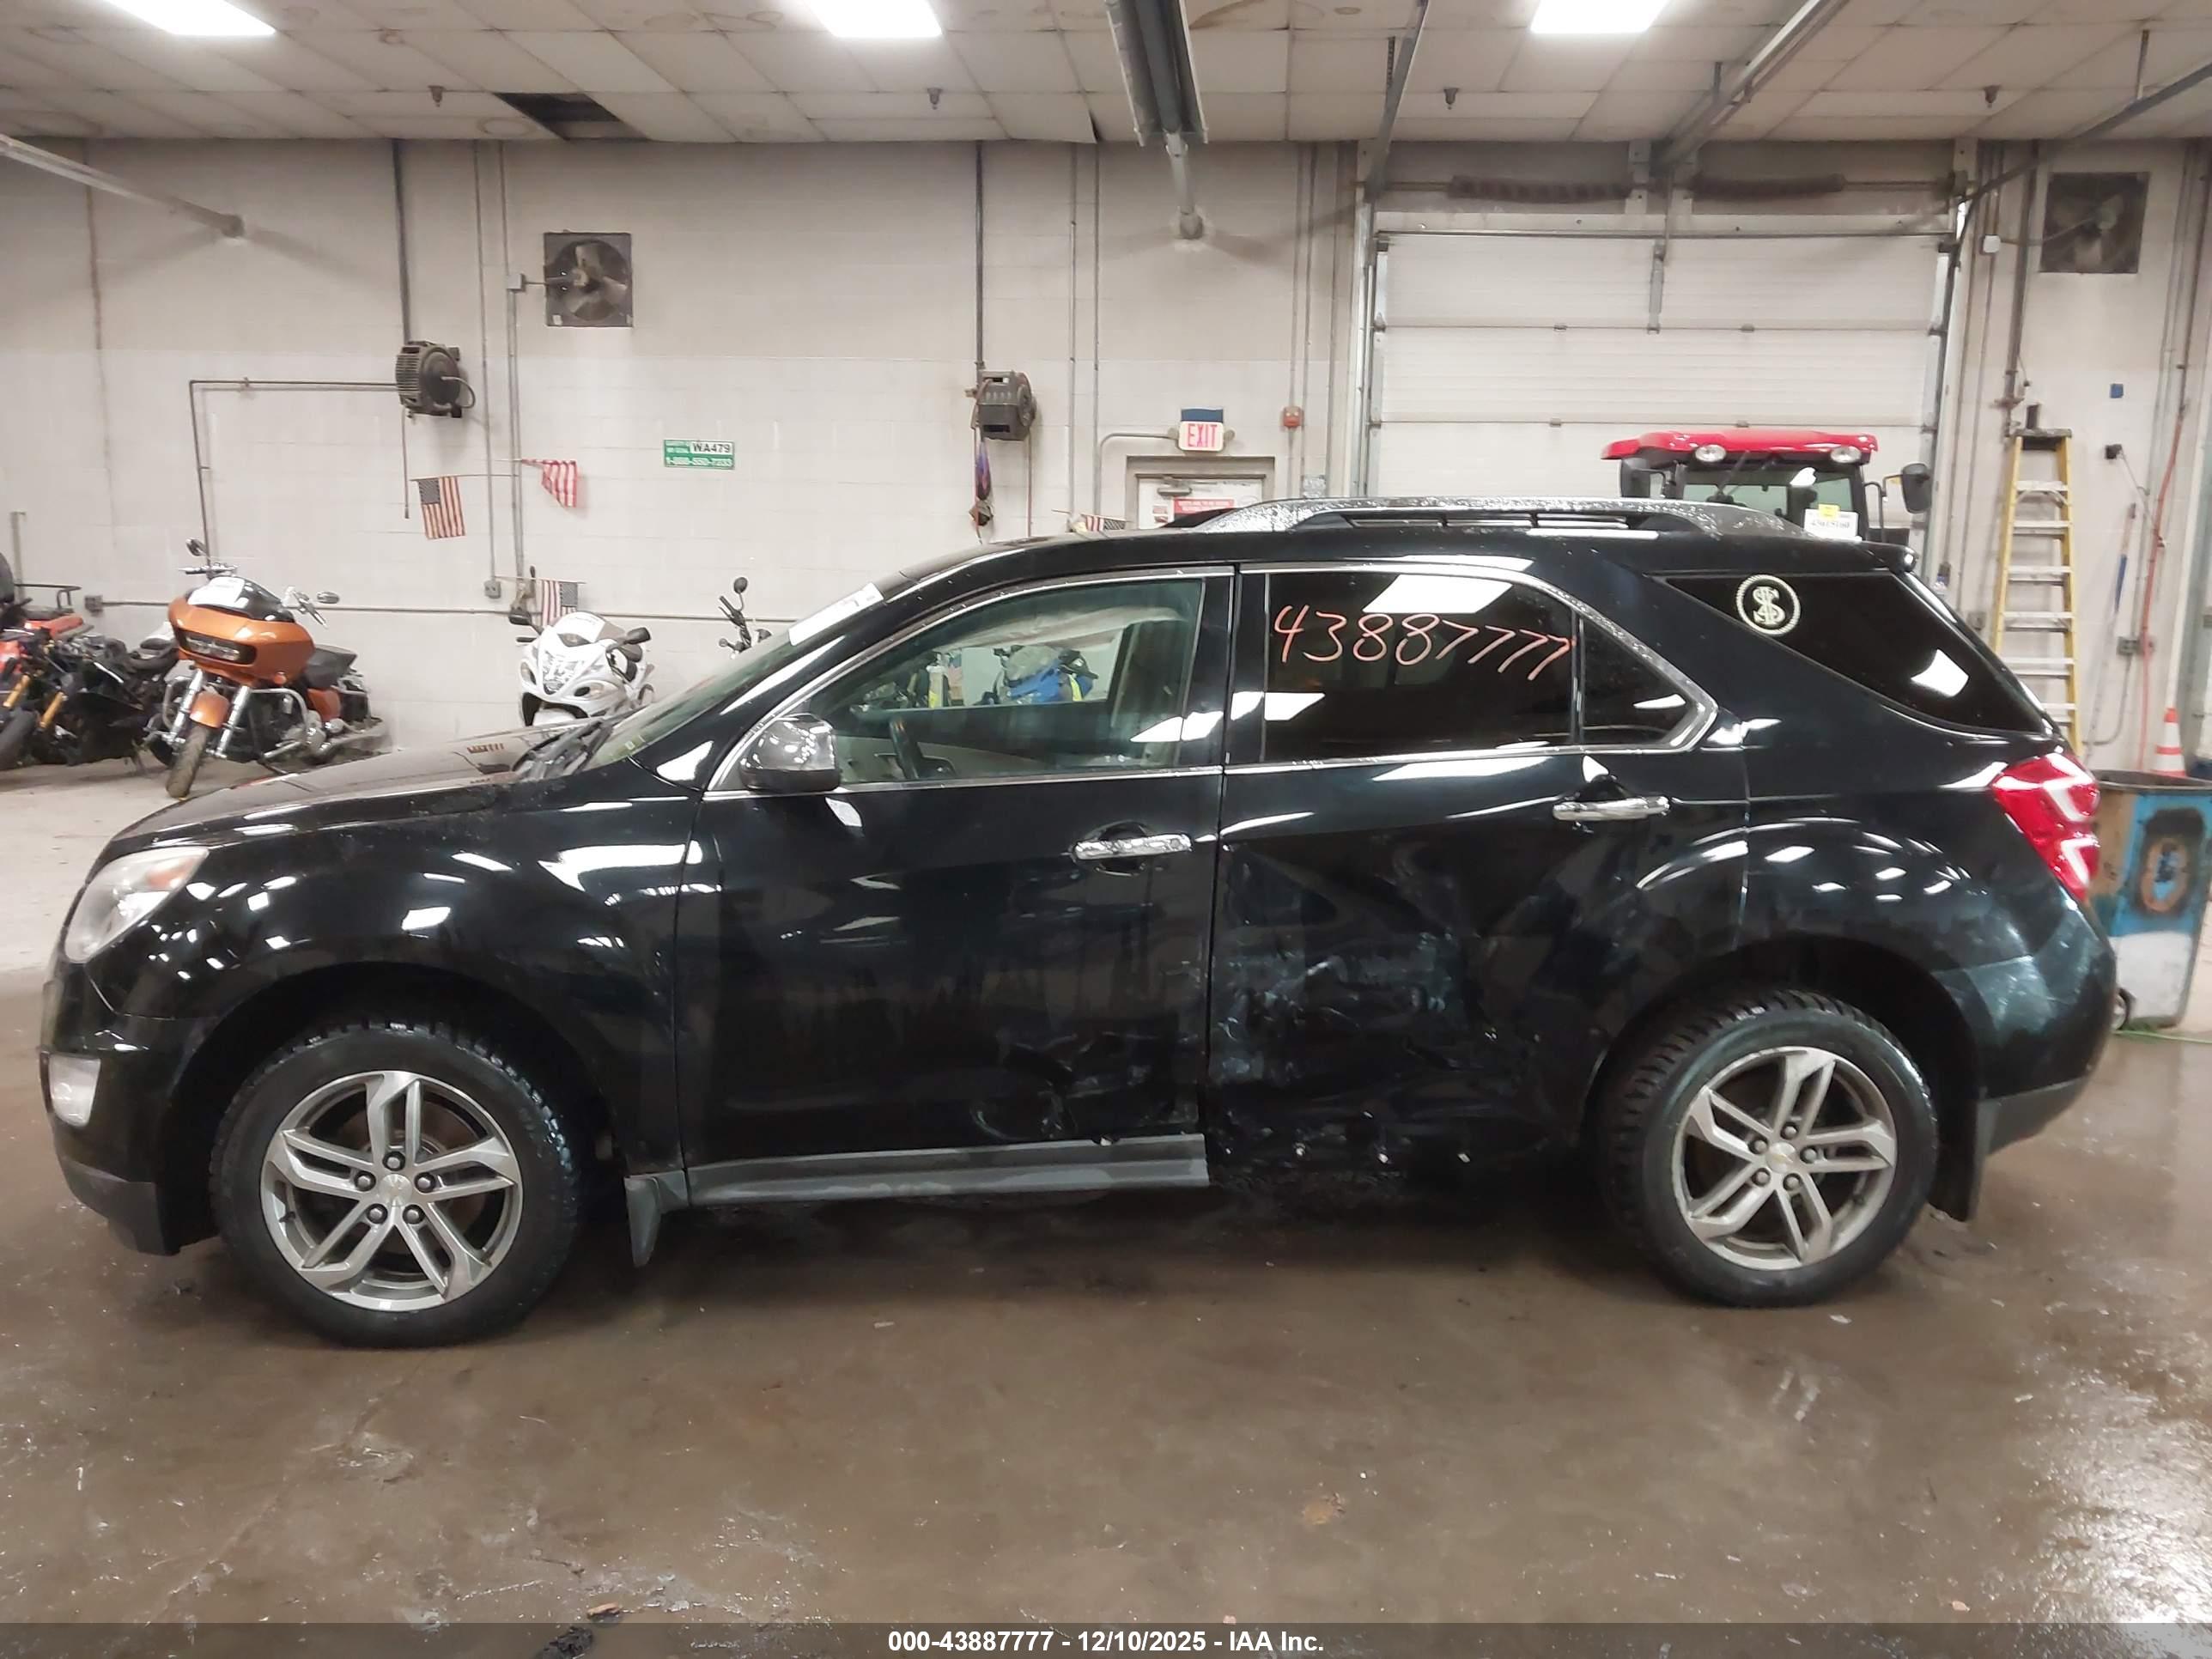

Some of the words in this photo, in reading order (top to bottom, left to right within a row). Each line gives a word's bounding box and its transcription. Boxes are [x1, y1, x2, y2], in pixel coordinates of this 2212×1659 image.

[1188, 423, 1218, 447] EXIT
[692, 442, 731, 453] WA479
[1274, 605, 1577, 681] 43887777
